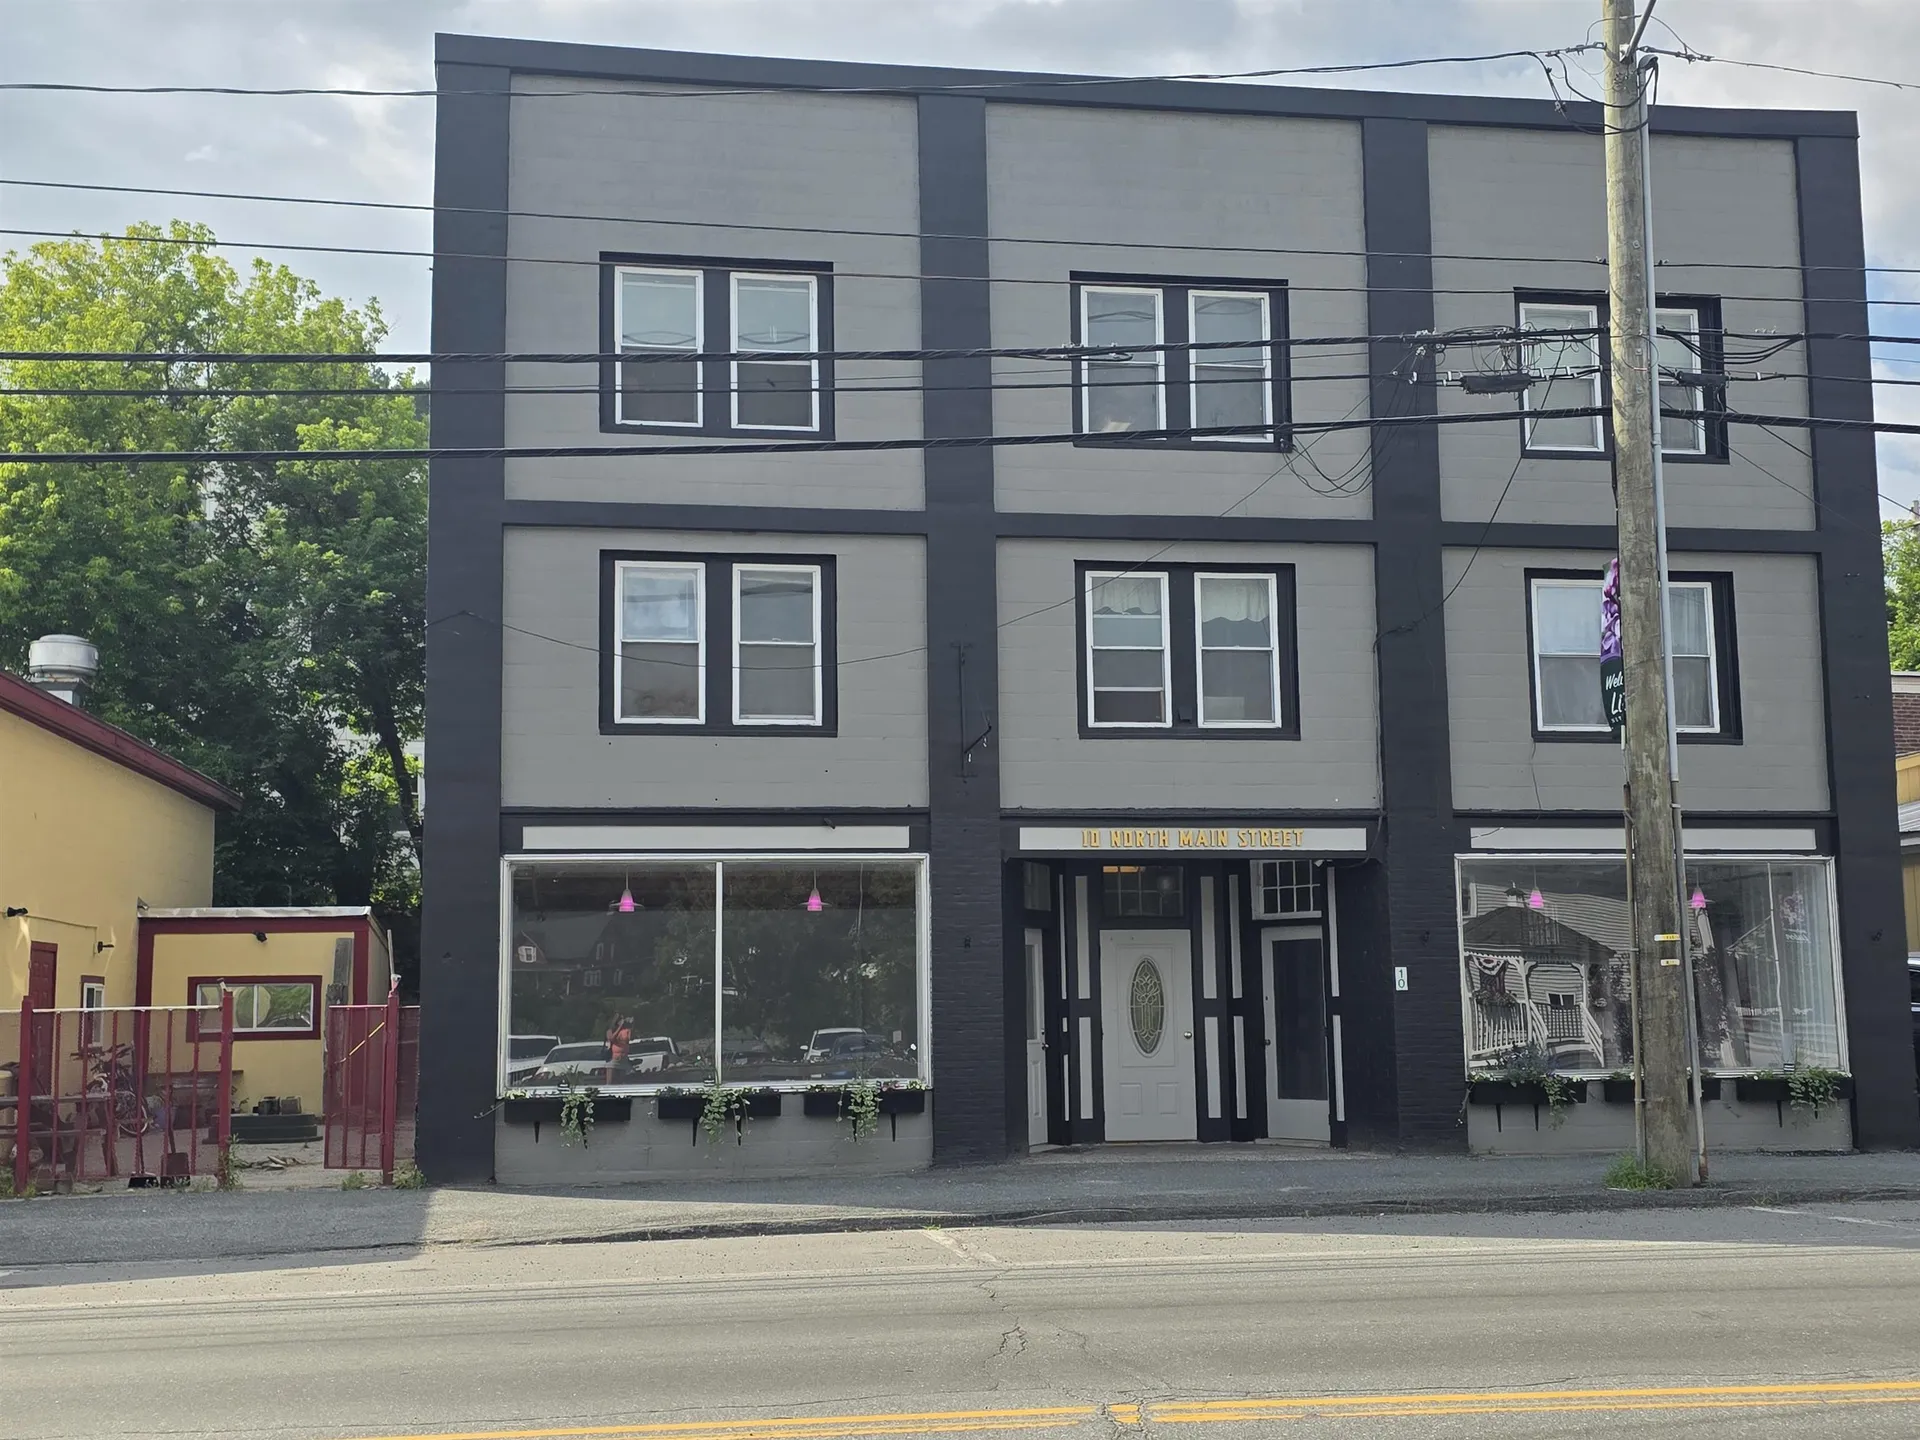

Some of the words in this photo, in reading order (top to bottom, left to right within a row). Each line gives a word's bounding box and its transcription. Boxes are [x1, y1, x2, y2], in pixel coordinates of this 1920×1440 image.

[1611, 691, 1626, 715] Li
[1082, 828, 1100, 847] 10
[1110, 828, 1169, 847] NORTH
[1178, 828, 1229, 847] MAIN
[1237, 828, 1304, 847] STREET
[1397, 968, 1406, 989] 10
